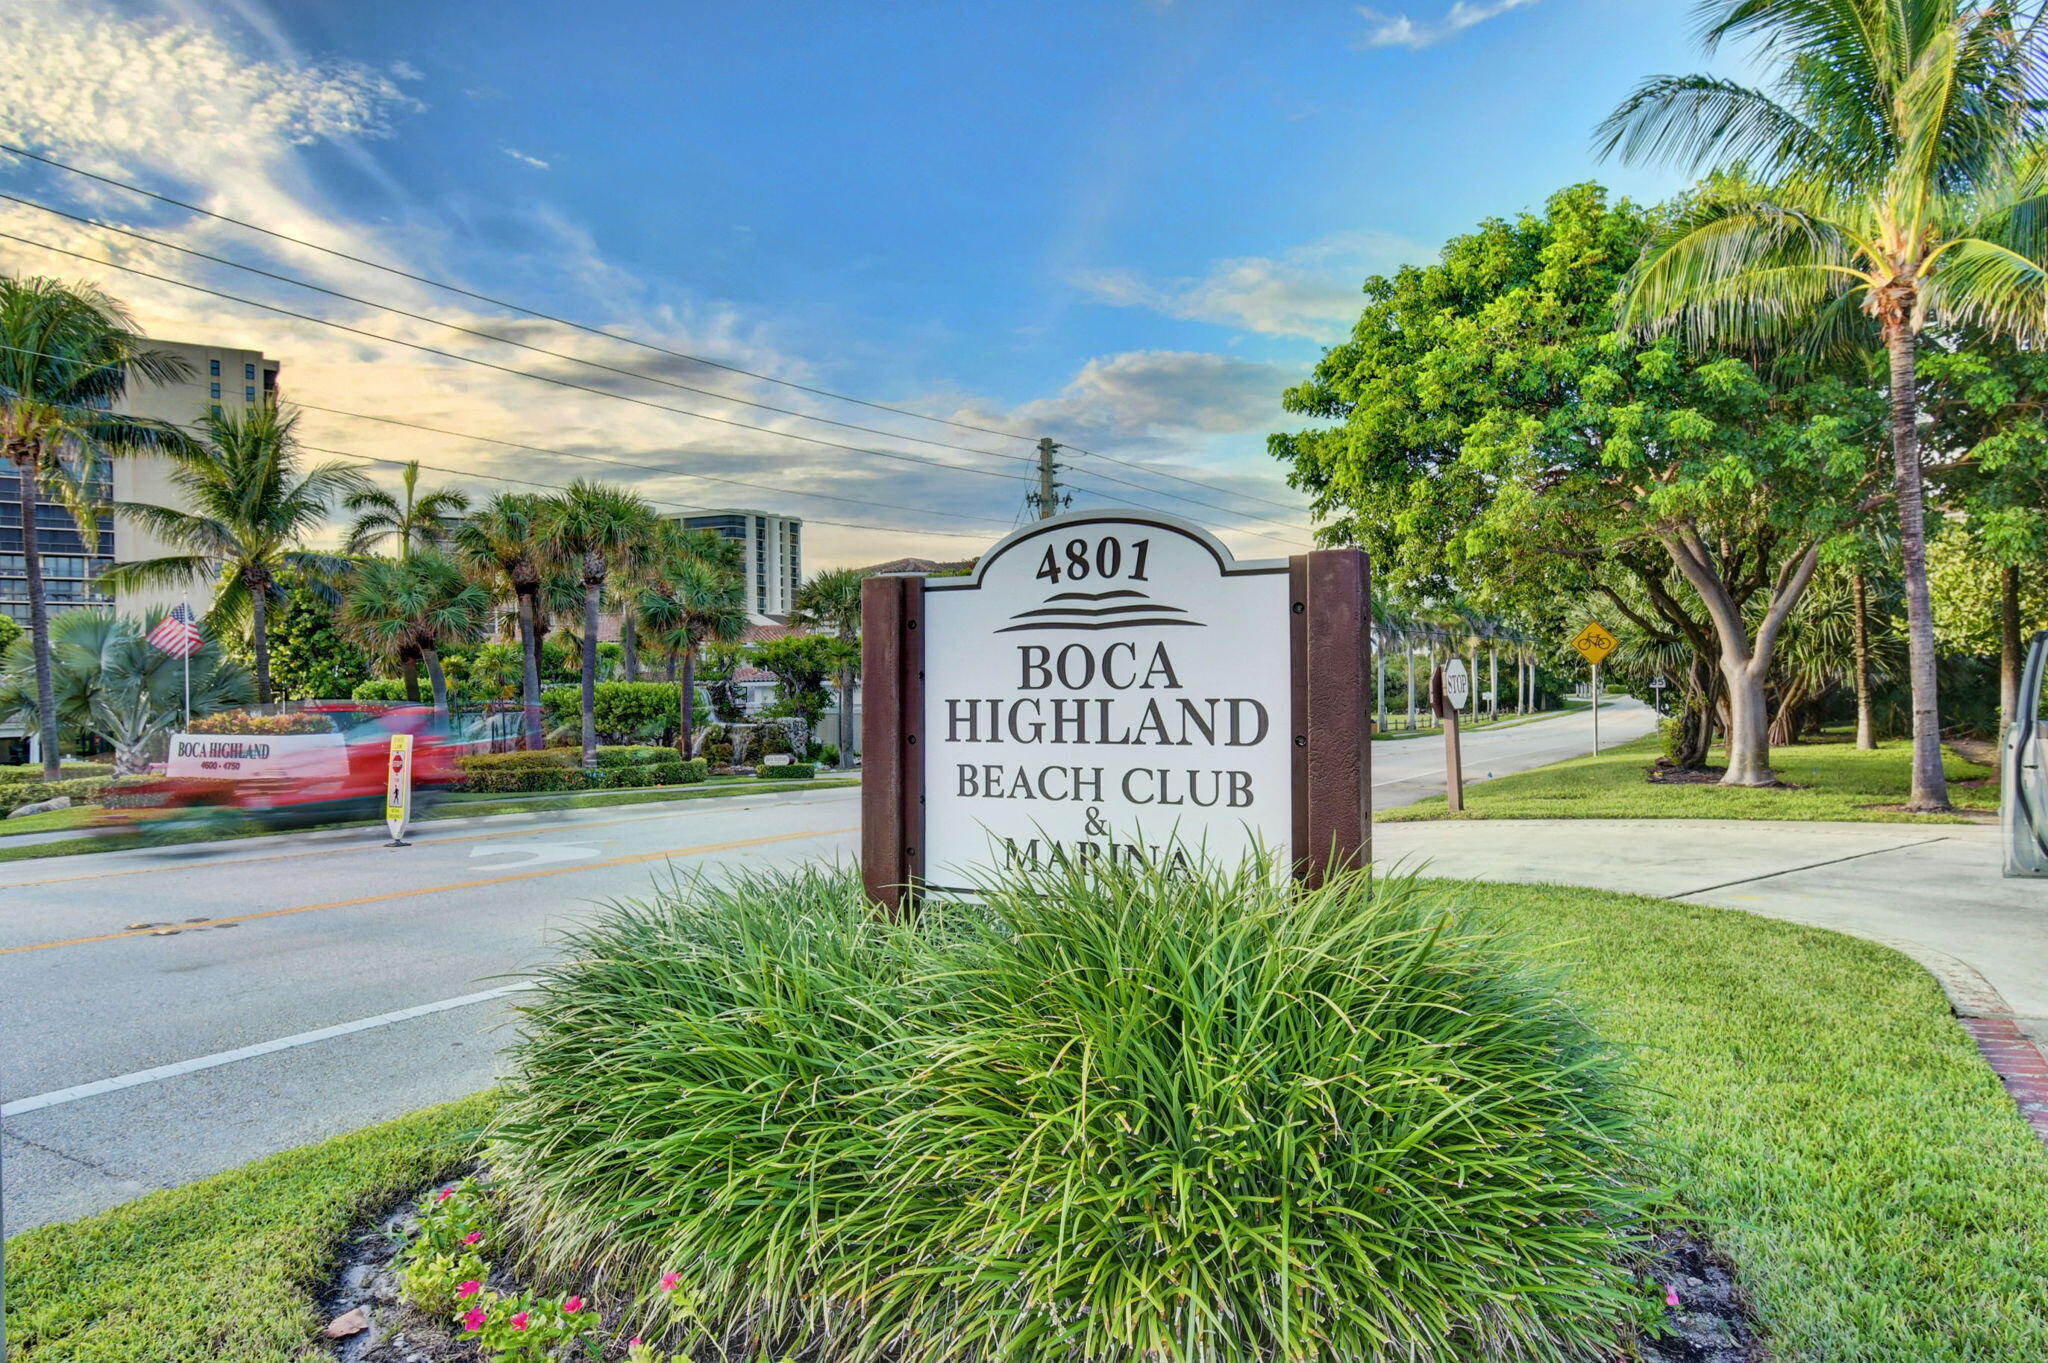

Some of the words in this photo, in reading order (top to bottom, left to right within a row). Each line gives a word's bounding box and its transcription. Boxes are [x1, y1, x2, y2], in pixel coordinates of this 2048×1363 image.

[1036, 536, 1150, 584] 4801
[1017, 641, 1183, 690] BOCA
[1447, 674, 1467, 694] STOP
[944, 697, 1270, 747] HIGHLAND
[178, 741, 206, 758] BOCA
[209, 742, 270, 760] HIGHLAND
[201, 761, 217, 770] 4600
[956, 763, 1105, 802] BEACH
[1121, 767, 1255, 808] CLUB
[1084, 806, 1109, 836] &
